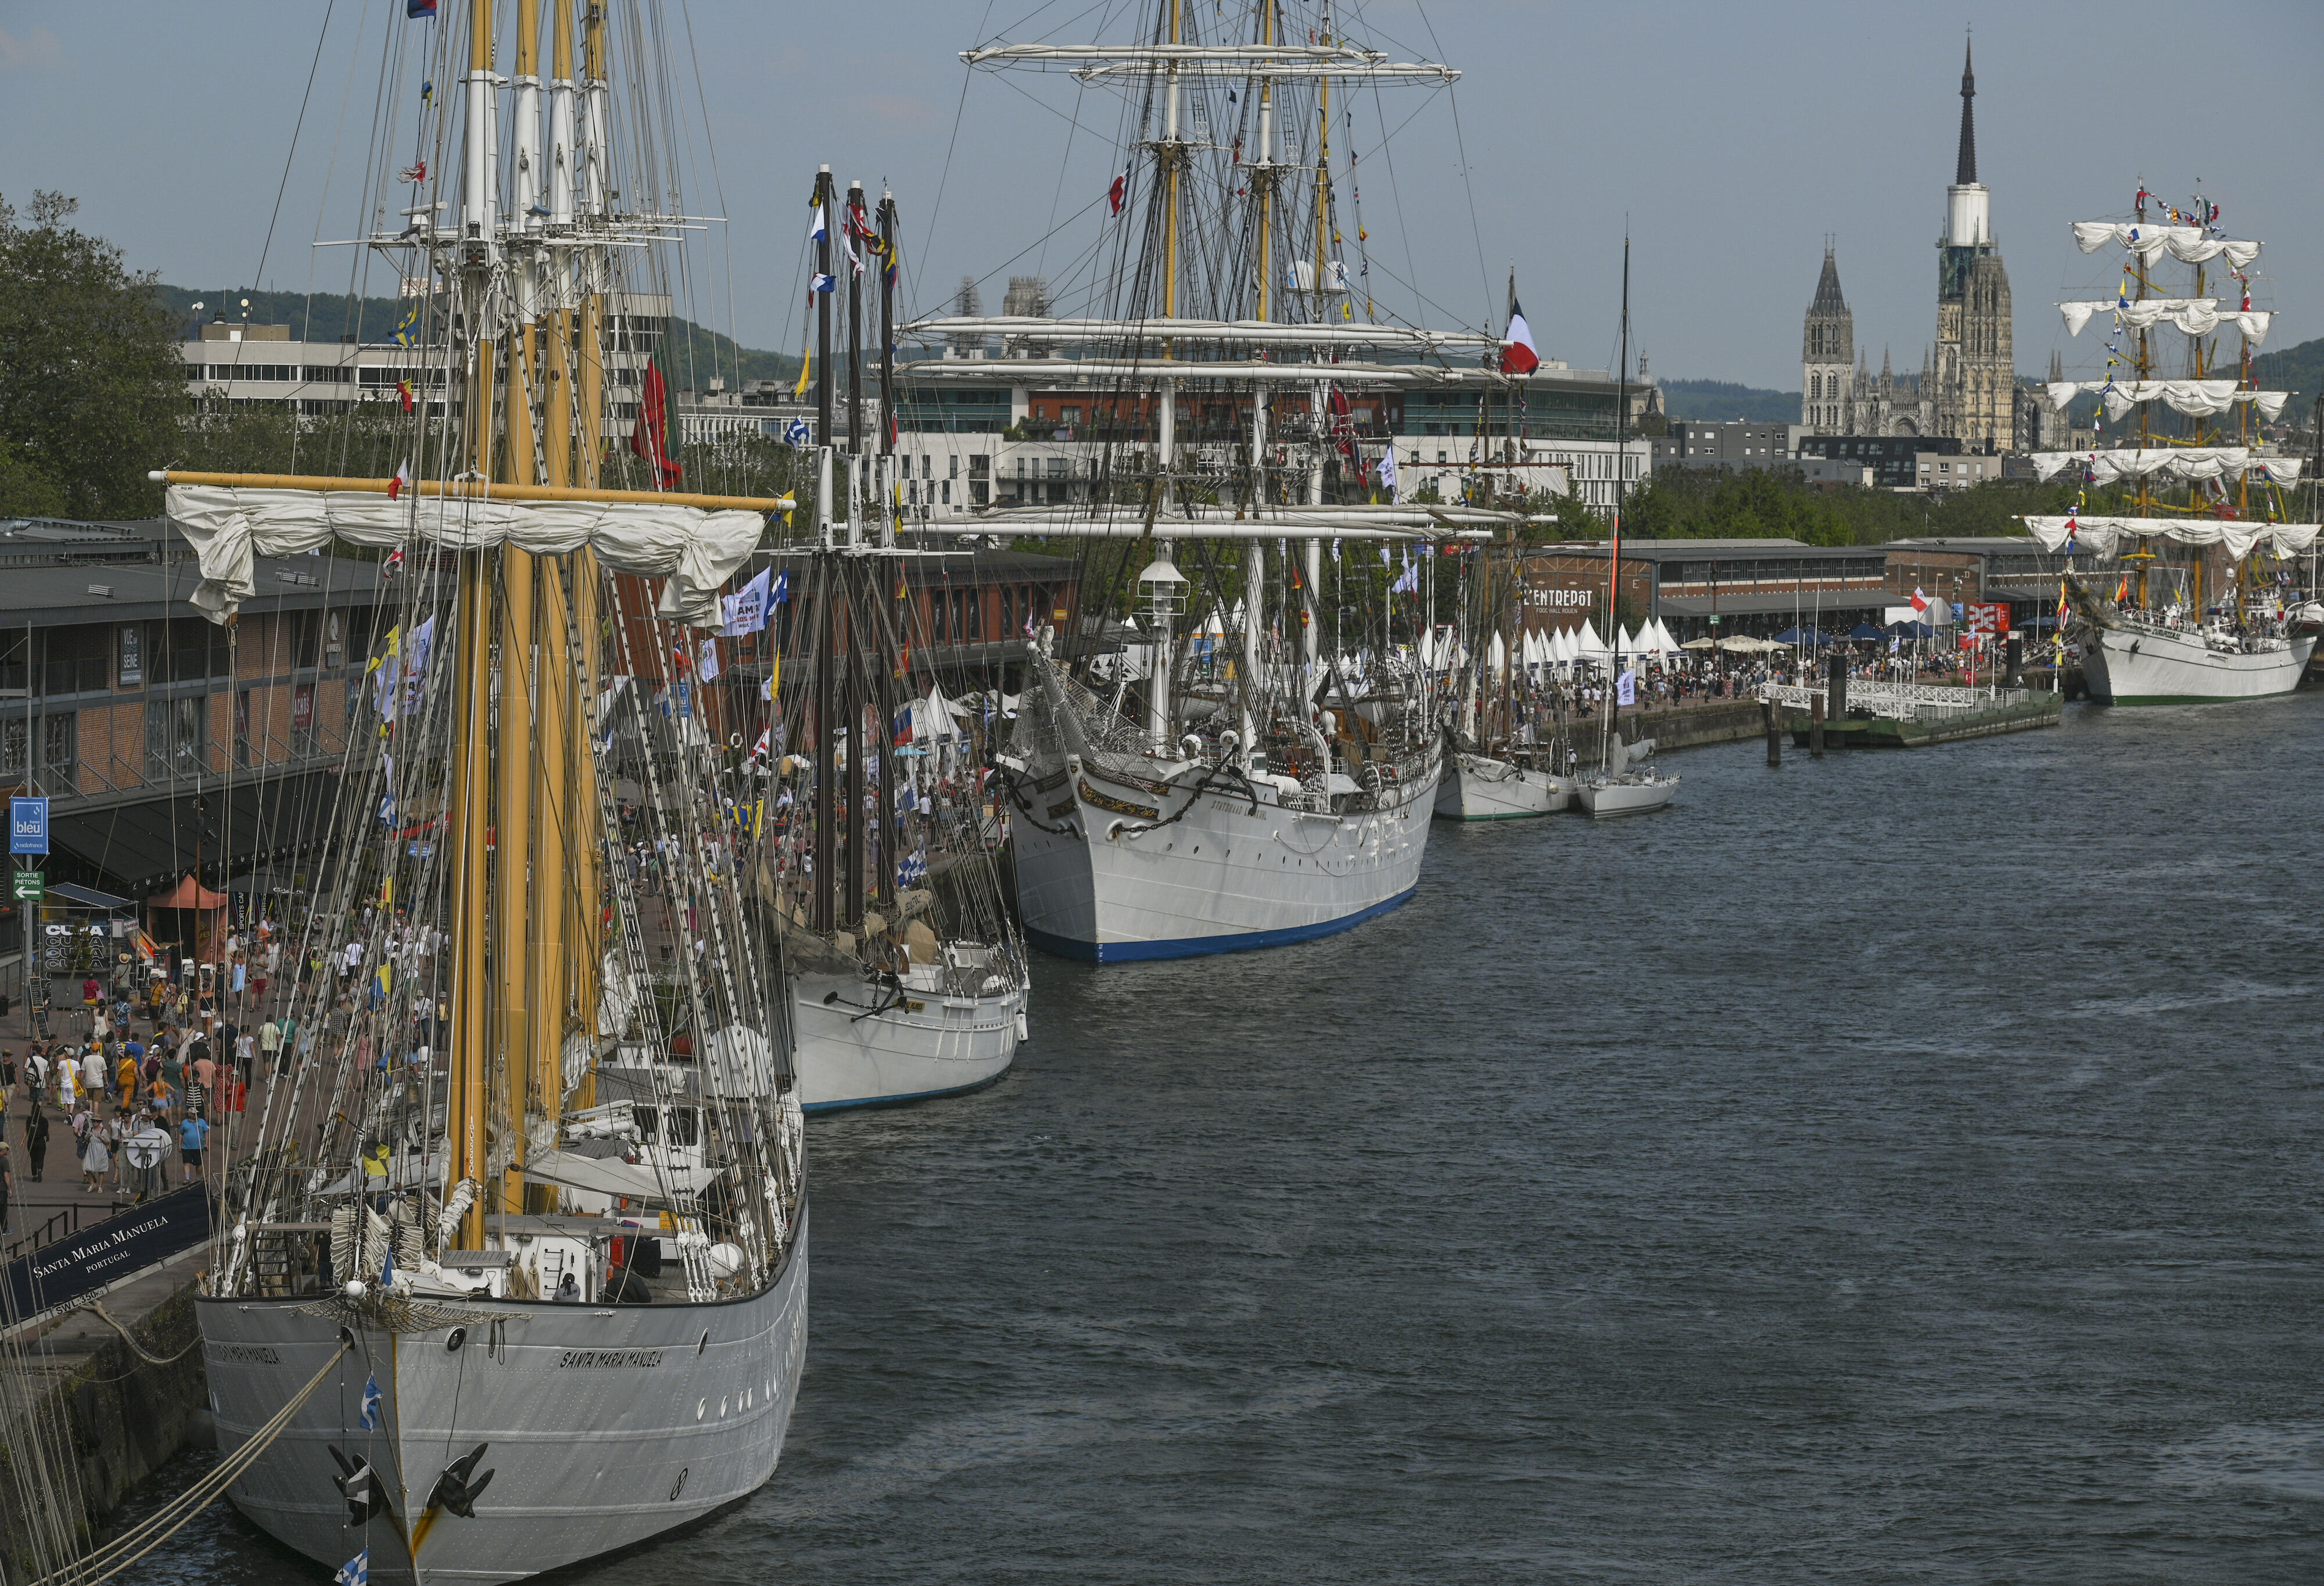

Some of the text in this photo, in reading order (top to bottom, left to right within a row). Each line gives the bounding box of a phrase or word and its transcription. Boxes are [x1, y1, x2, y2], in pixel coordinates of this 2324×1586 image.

[1633, 579, 1640, 588] E
[124, 629, 133, 645] VUE
[123, 653, 138, 668] SEINE
[1244, 807, 1267, 821] LKUHL
[16, 821, 40, 833] bleu
[45, 936, 104, 947] CUA
[33, 1216, 169, 1279] SANTA MARIA MANUELA
[85, 1250, 131, 1274] PORTUGAL
[562, 1288, 578, 1297] CW
[246, 1347, 282, 1364] MANUELA
[560, 1351, 664, 1368] SANTA MARIA MANUELA
